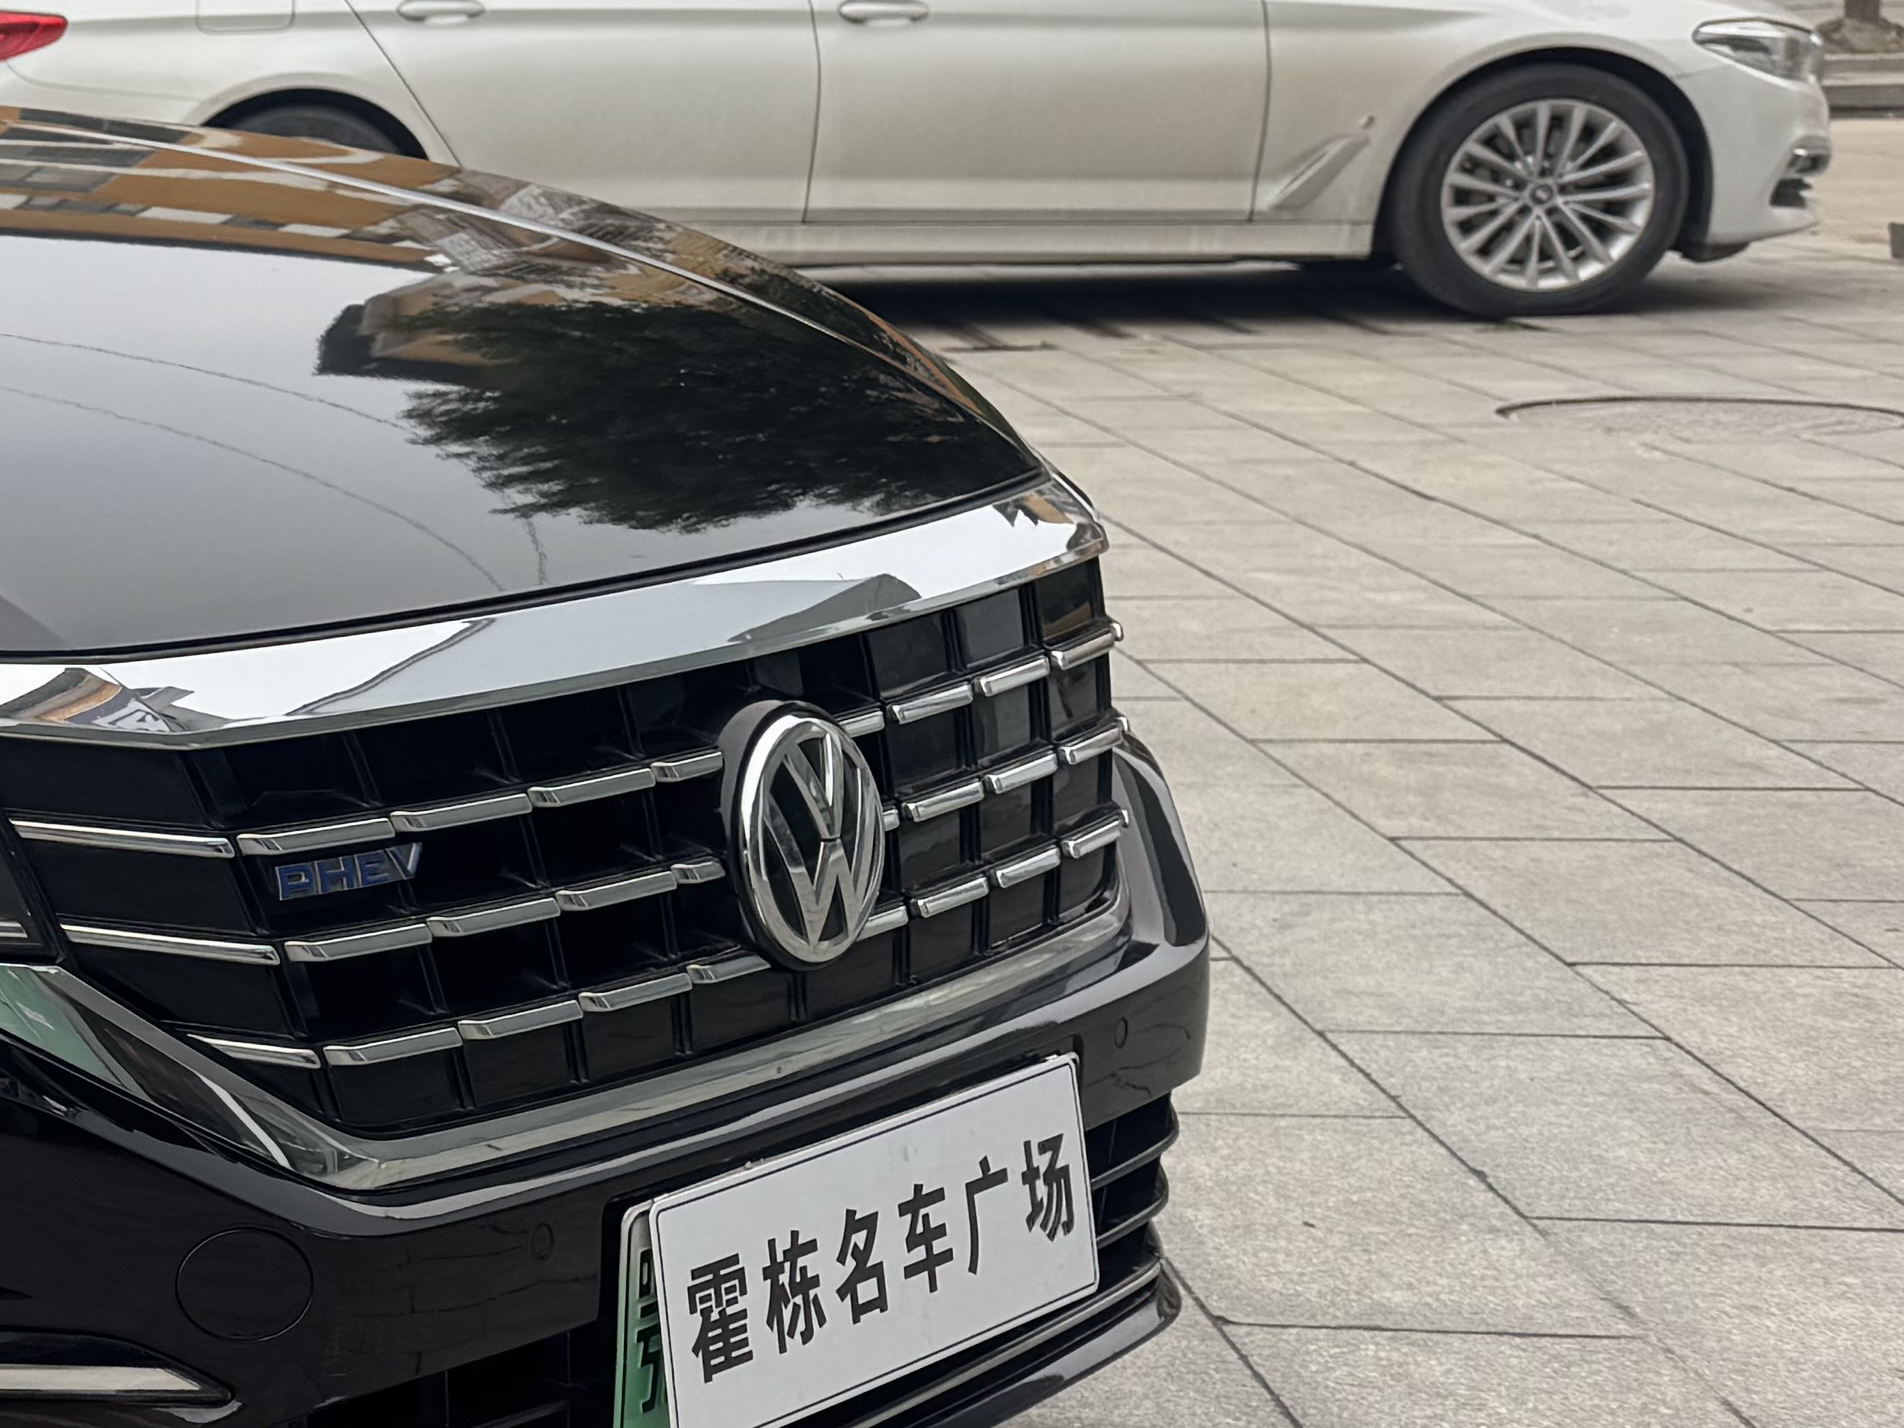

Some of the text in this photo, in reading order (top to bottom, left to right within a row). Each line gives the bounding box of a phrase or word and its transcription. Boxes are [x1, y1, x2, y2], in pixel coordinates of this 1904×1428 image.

[275, 841, 422, 901] PHEV
[687, 1133, 1075, 1384] 霍栋名车广场
